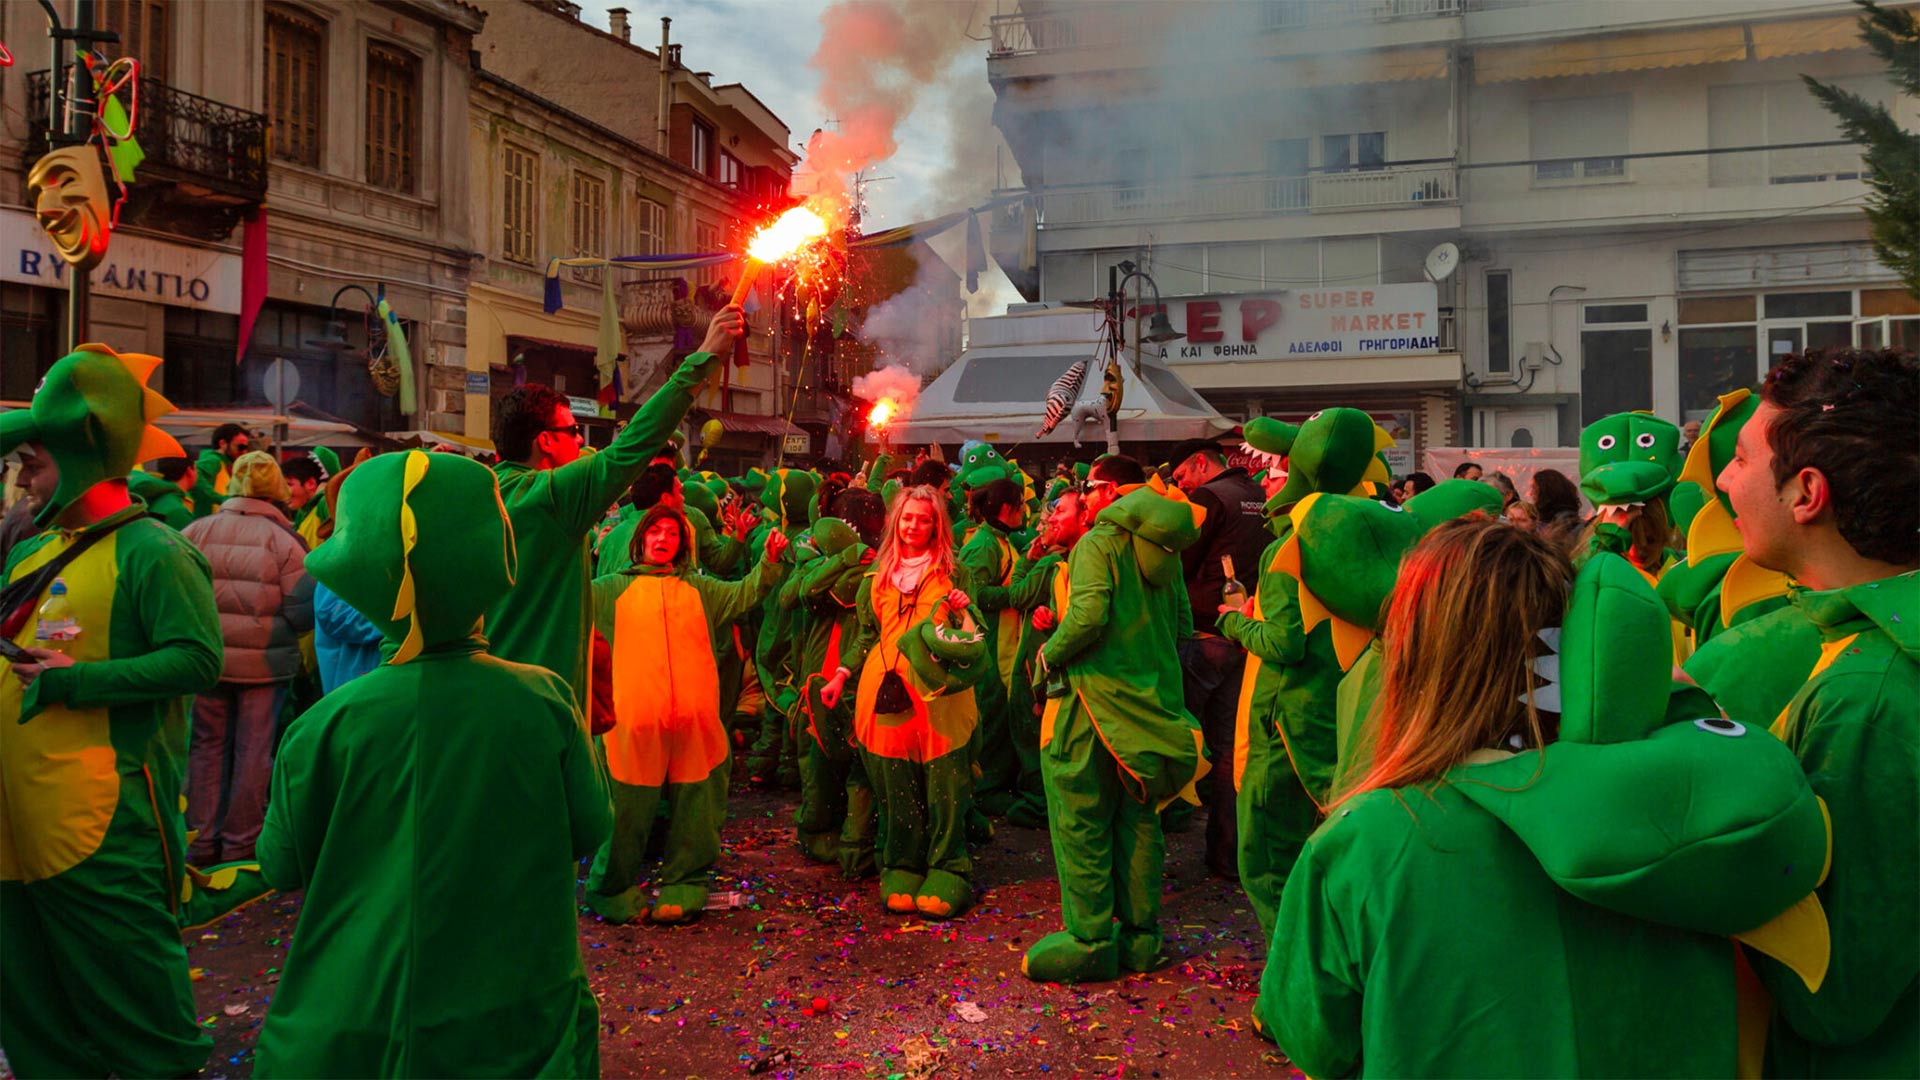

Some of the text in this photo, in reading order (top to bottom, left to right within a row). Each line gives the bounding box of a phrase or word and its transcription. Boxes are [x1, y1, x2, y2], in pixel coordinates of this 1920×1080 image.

[20, 249, 210, 301] ΒΥΑΝΤΙΟ
[1300, 290, 1376, 309] SUPER
[1331, 312, 1427, 332] MARKET
[1180, 345, 1202, 358] ΚΑΙ
[1213, 344, 1258, 356] ΦΘΗΝΑ
[1289, 336, 1440, 353] ΑΔΕΛΦΟΙ ΓΡΗΓΟΡΙΑΔΗ
